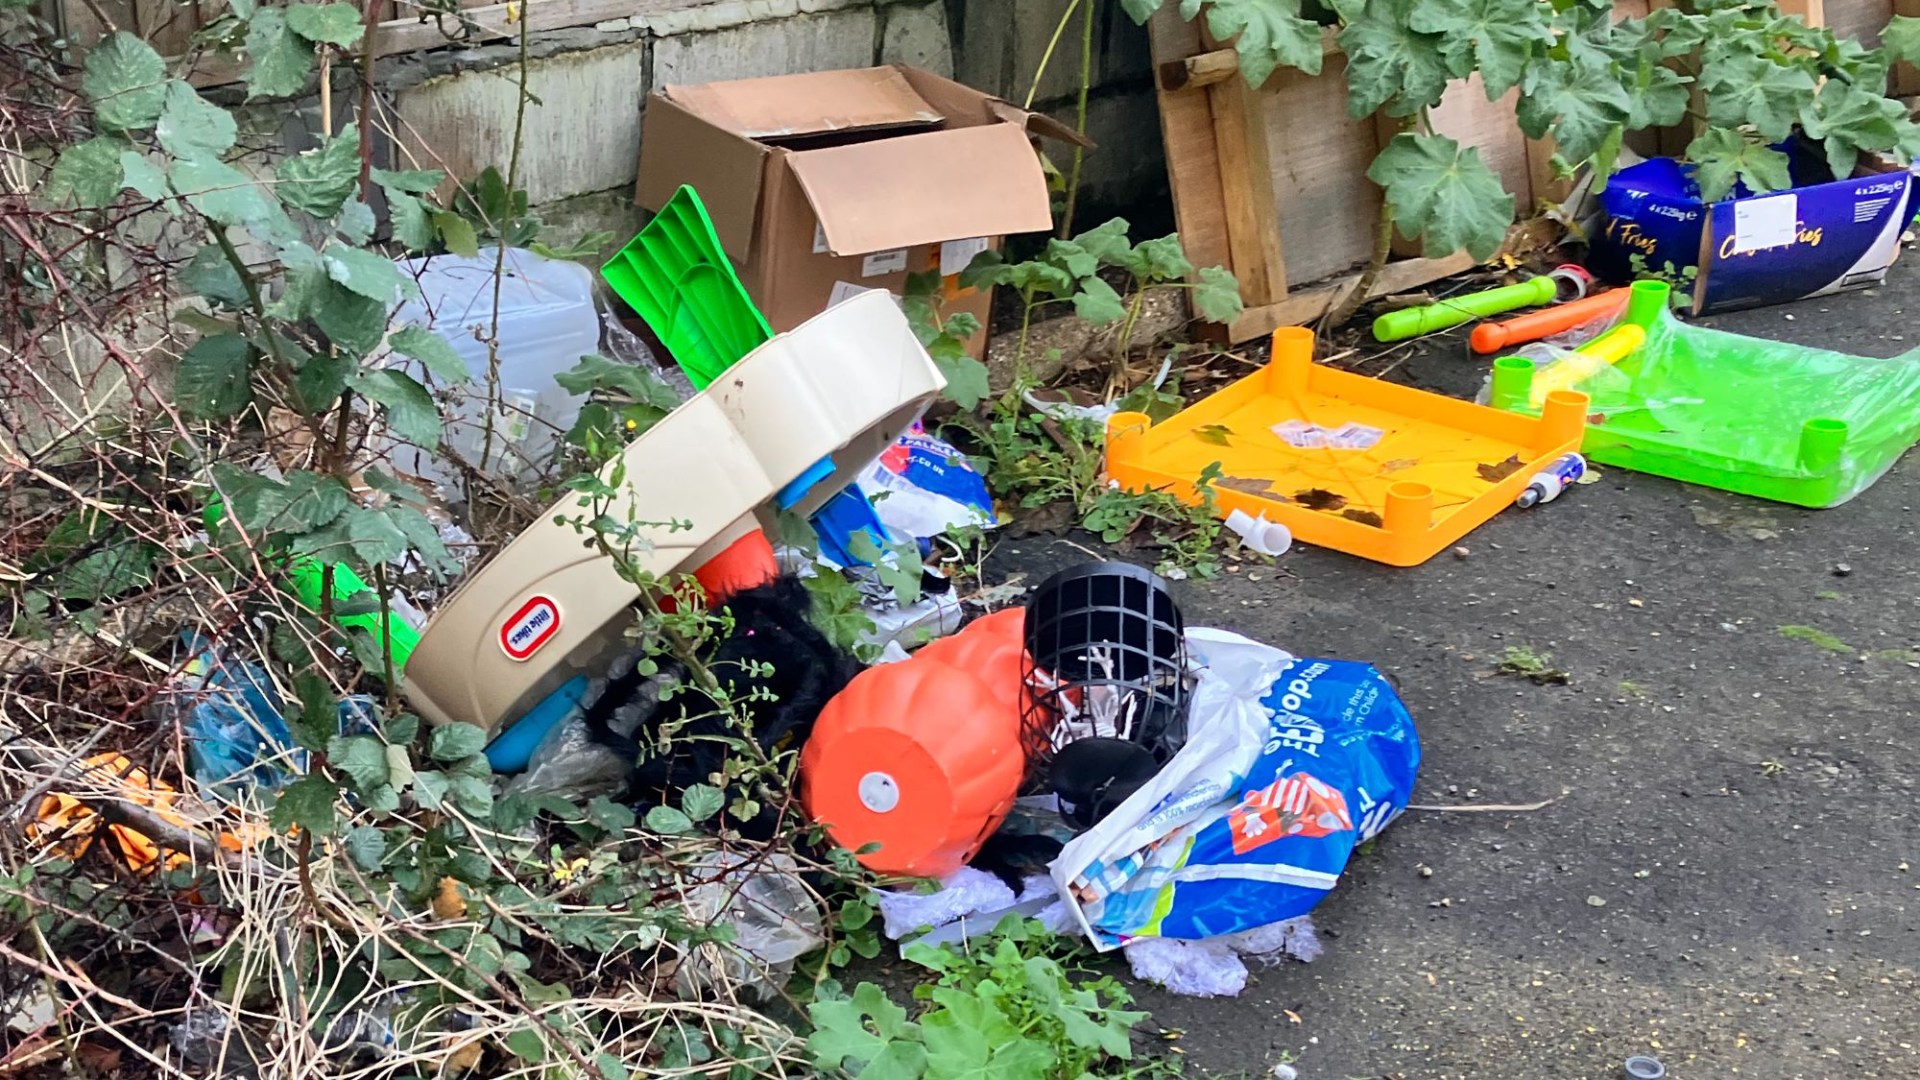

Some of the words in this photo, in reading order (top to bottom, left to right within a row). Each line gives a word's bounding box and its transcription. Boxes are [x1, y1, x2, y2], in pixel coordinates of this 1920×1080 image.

[1620, 223, 1658, 255] Fries
[529, 609, 550, 628] little
[511, 625, 532, 645] tikes
[1281, 662, 1332, 711] op.com
